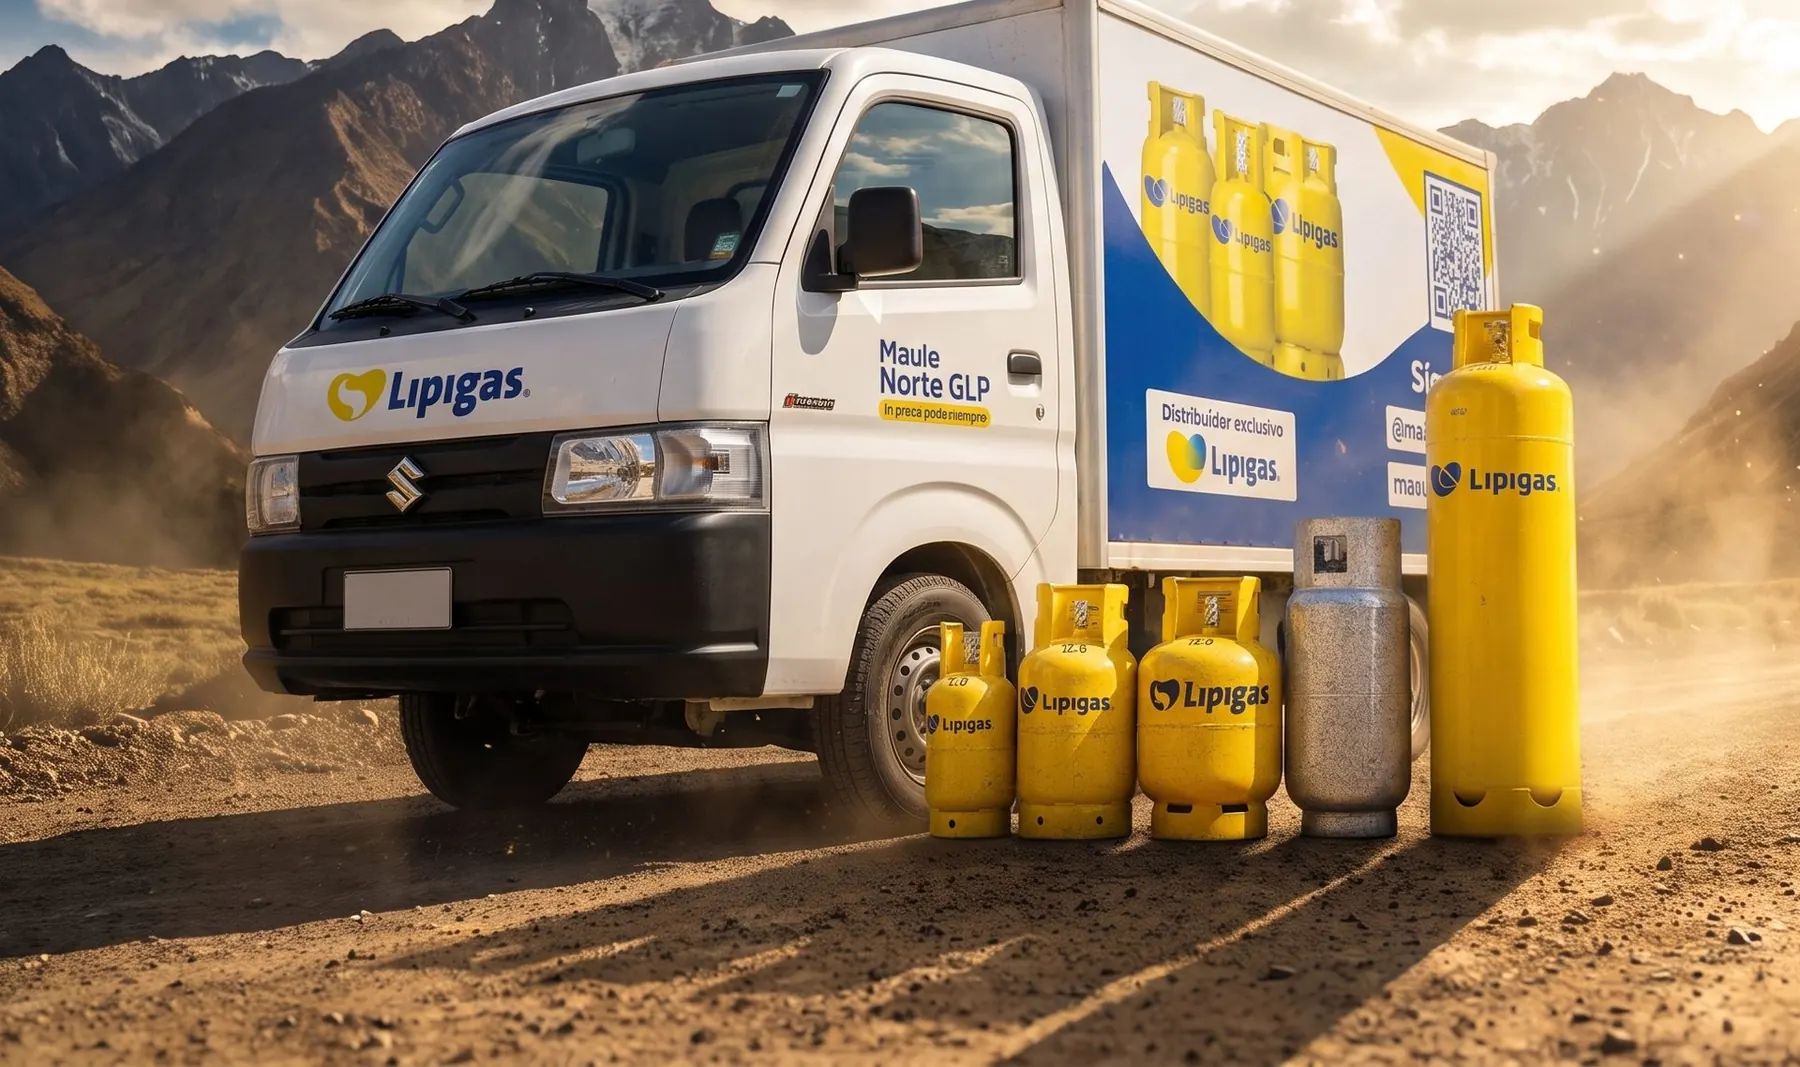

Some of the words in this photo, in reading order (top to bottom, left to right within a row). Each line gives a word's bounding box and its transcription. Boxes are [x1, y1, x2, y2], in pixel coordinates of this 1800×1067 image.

[1291, 212, 1338, 249] Lipigas
[880, 339, 940, 369] Maule
[880, 366, 943, 398] Norte
[949, 373, 990, 402] GLP
[1234, 417, 1284, 438] exclusivo
